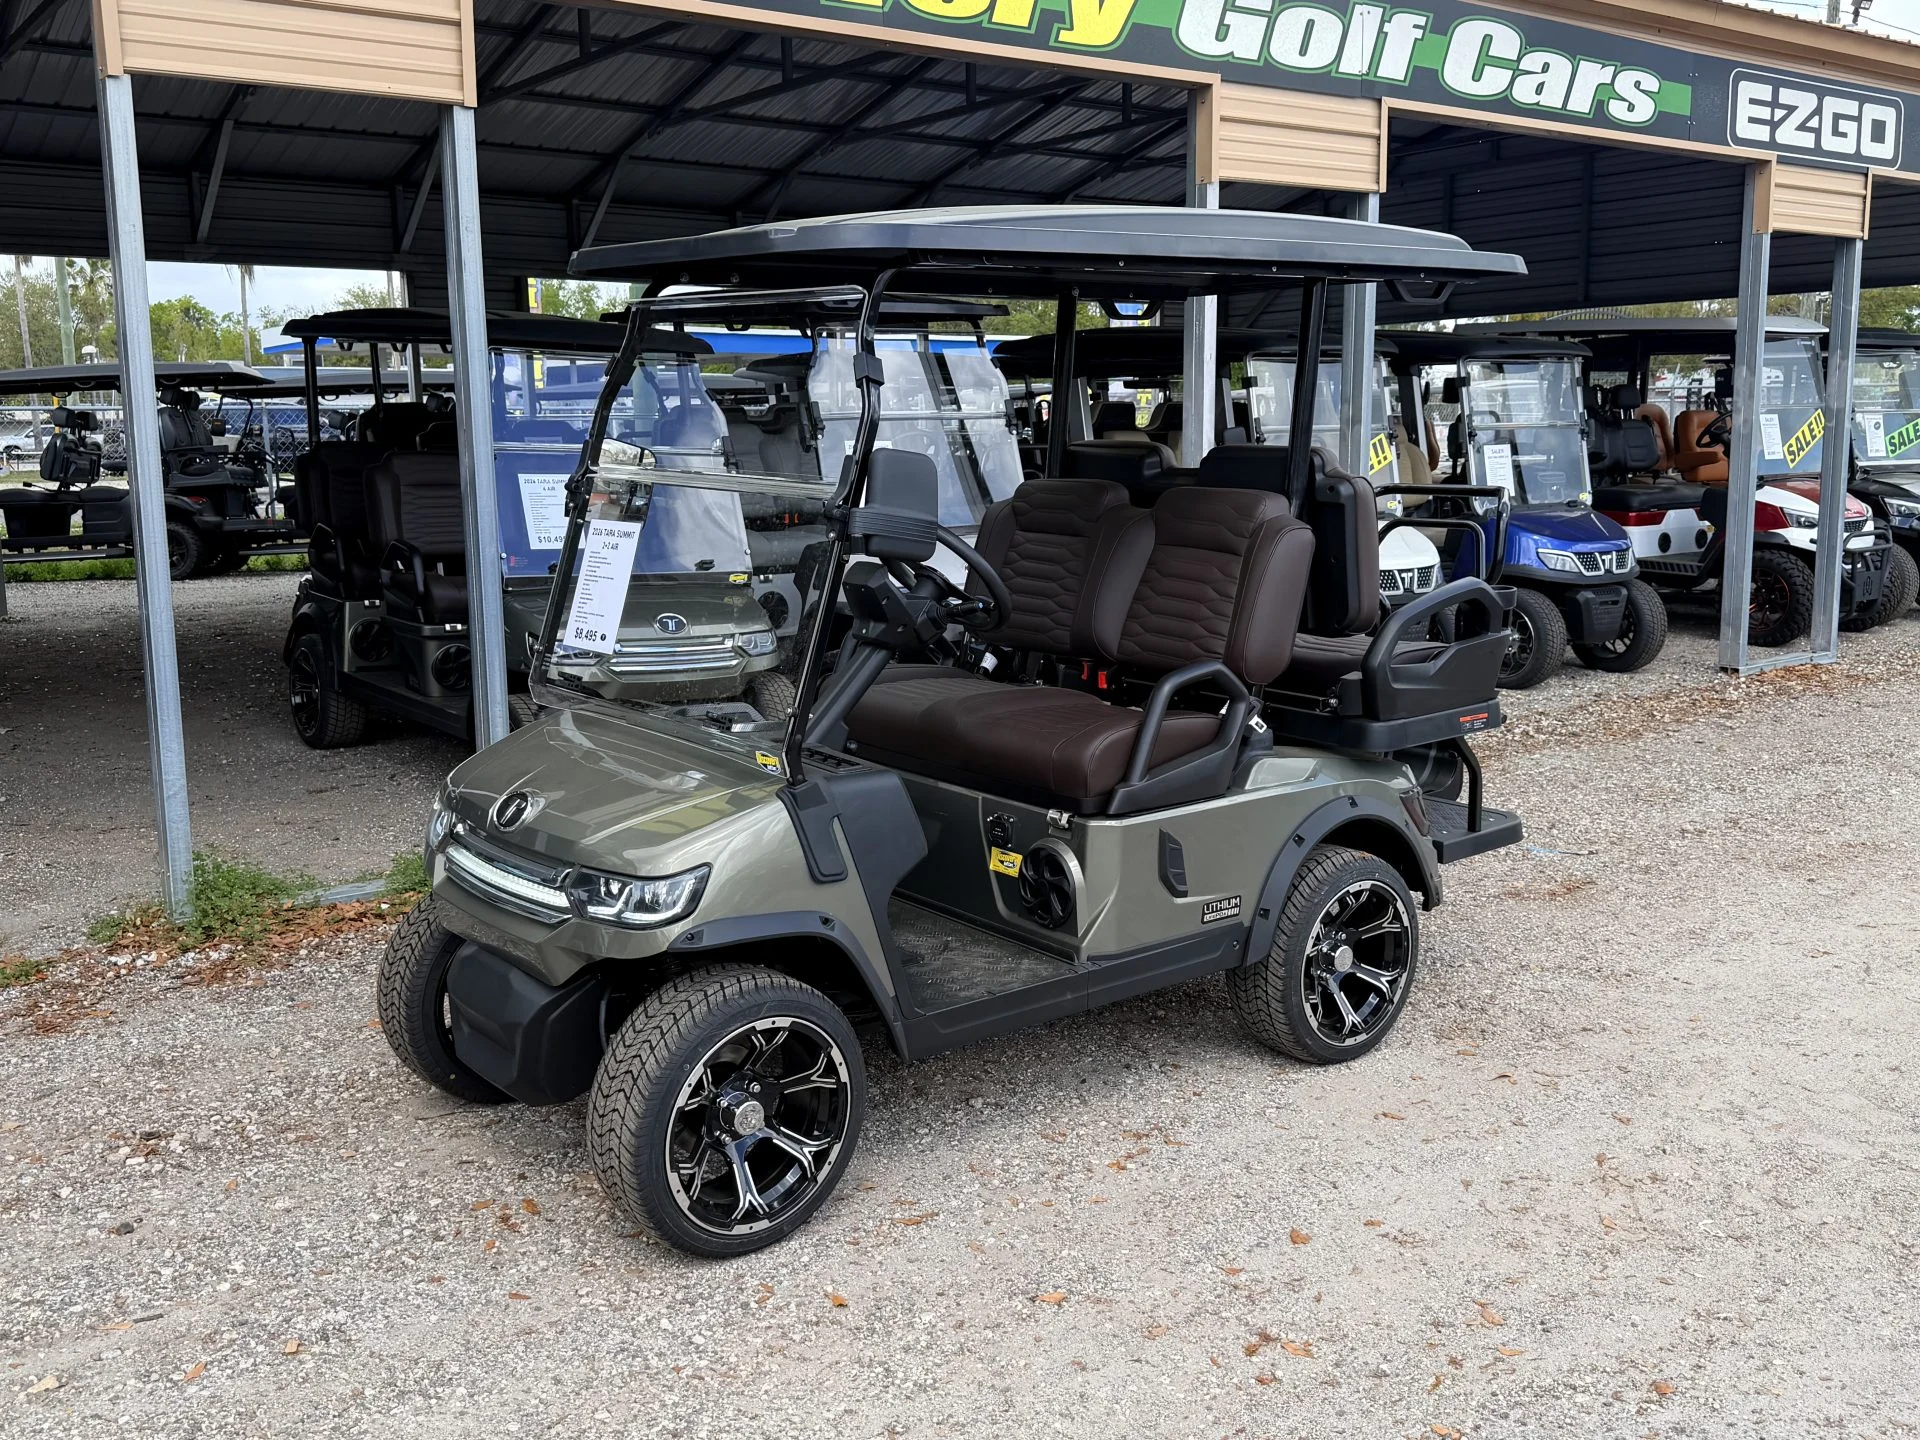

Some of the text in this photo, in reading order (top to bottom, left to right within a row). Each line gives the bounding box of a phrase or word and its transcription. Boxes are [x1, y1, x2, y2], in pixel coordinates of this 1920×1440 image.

[1179, 0, 1427, 81] Golf
[1443, 20, 1661, 123] Cars
[603, 528, 616, 538] TARA
[616, 529, 636, 540] SUMMIT
[610, 542, 619, 551] AIR
[574, 626, 598, 642] $8,495
[1204, 897, 1240, 914] LITHIUM
